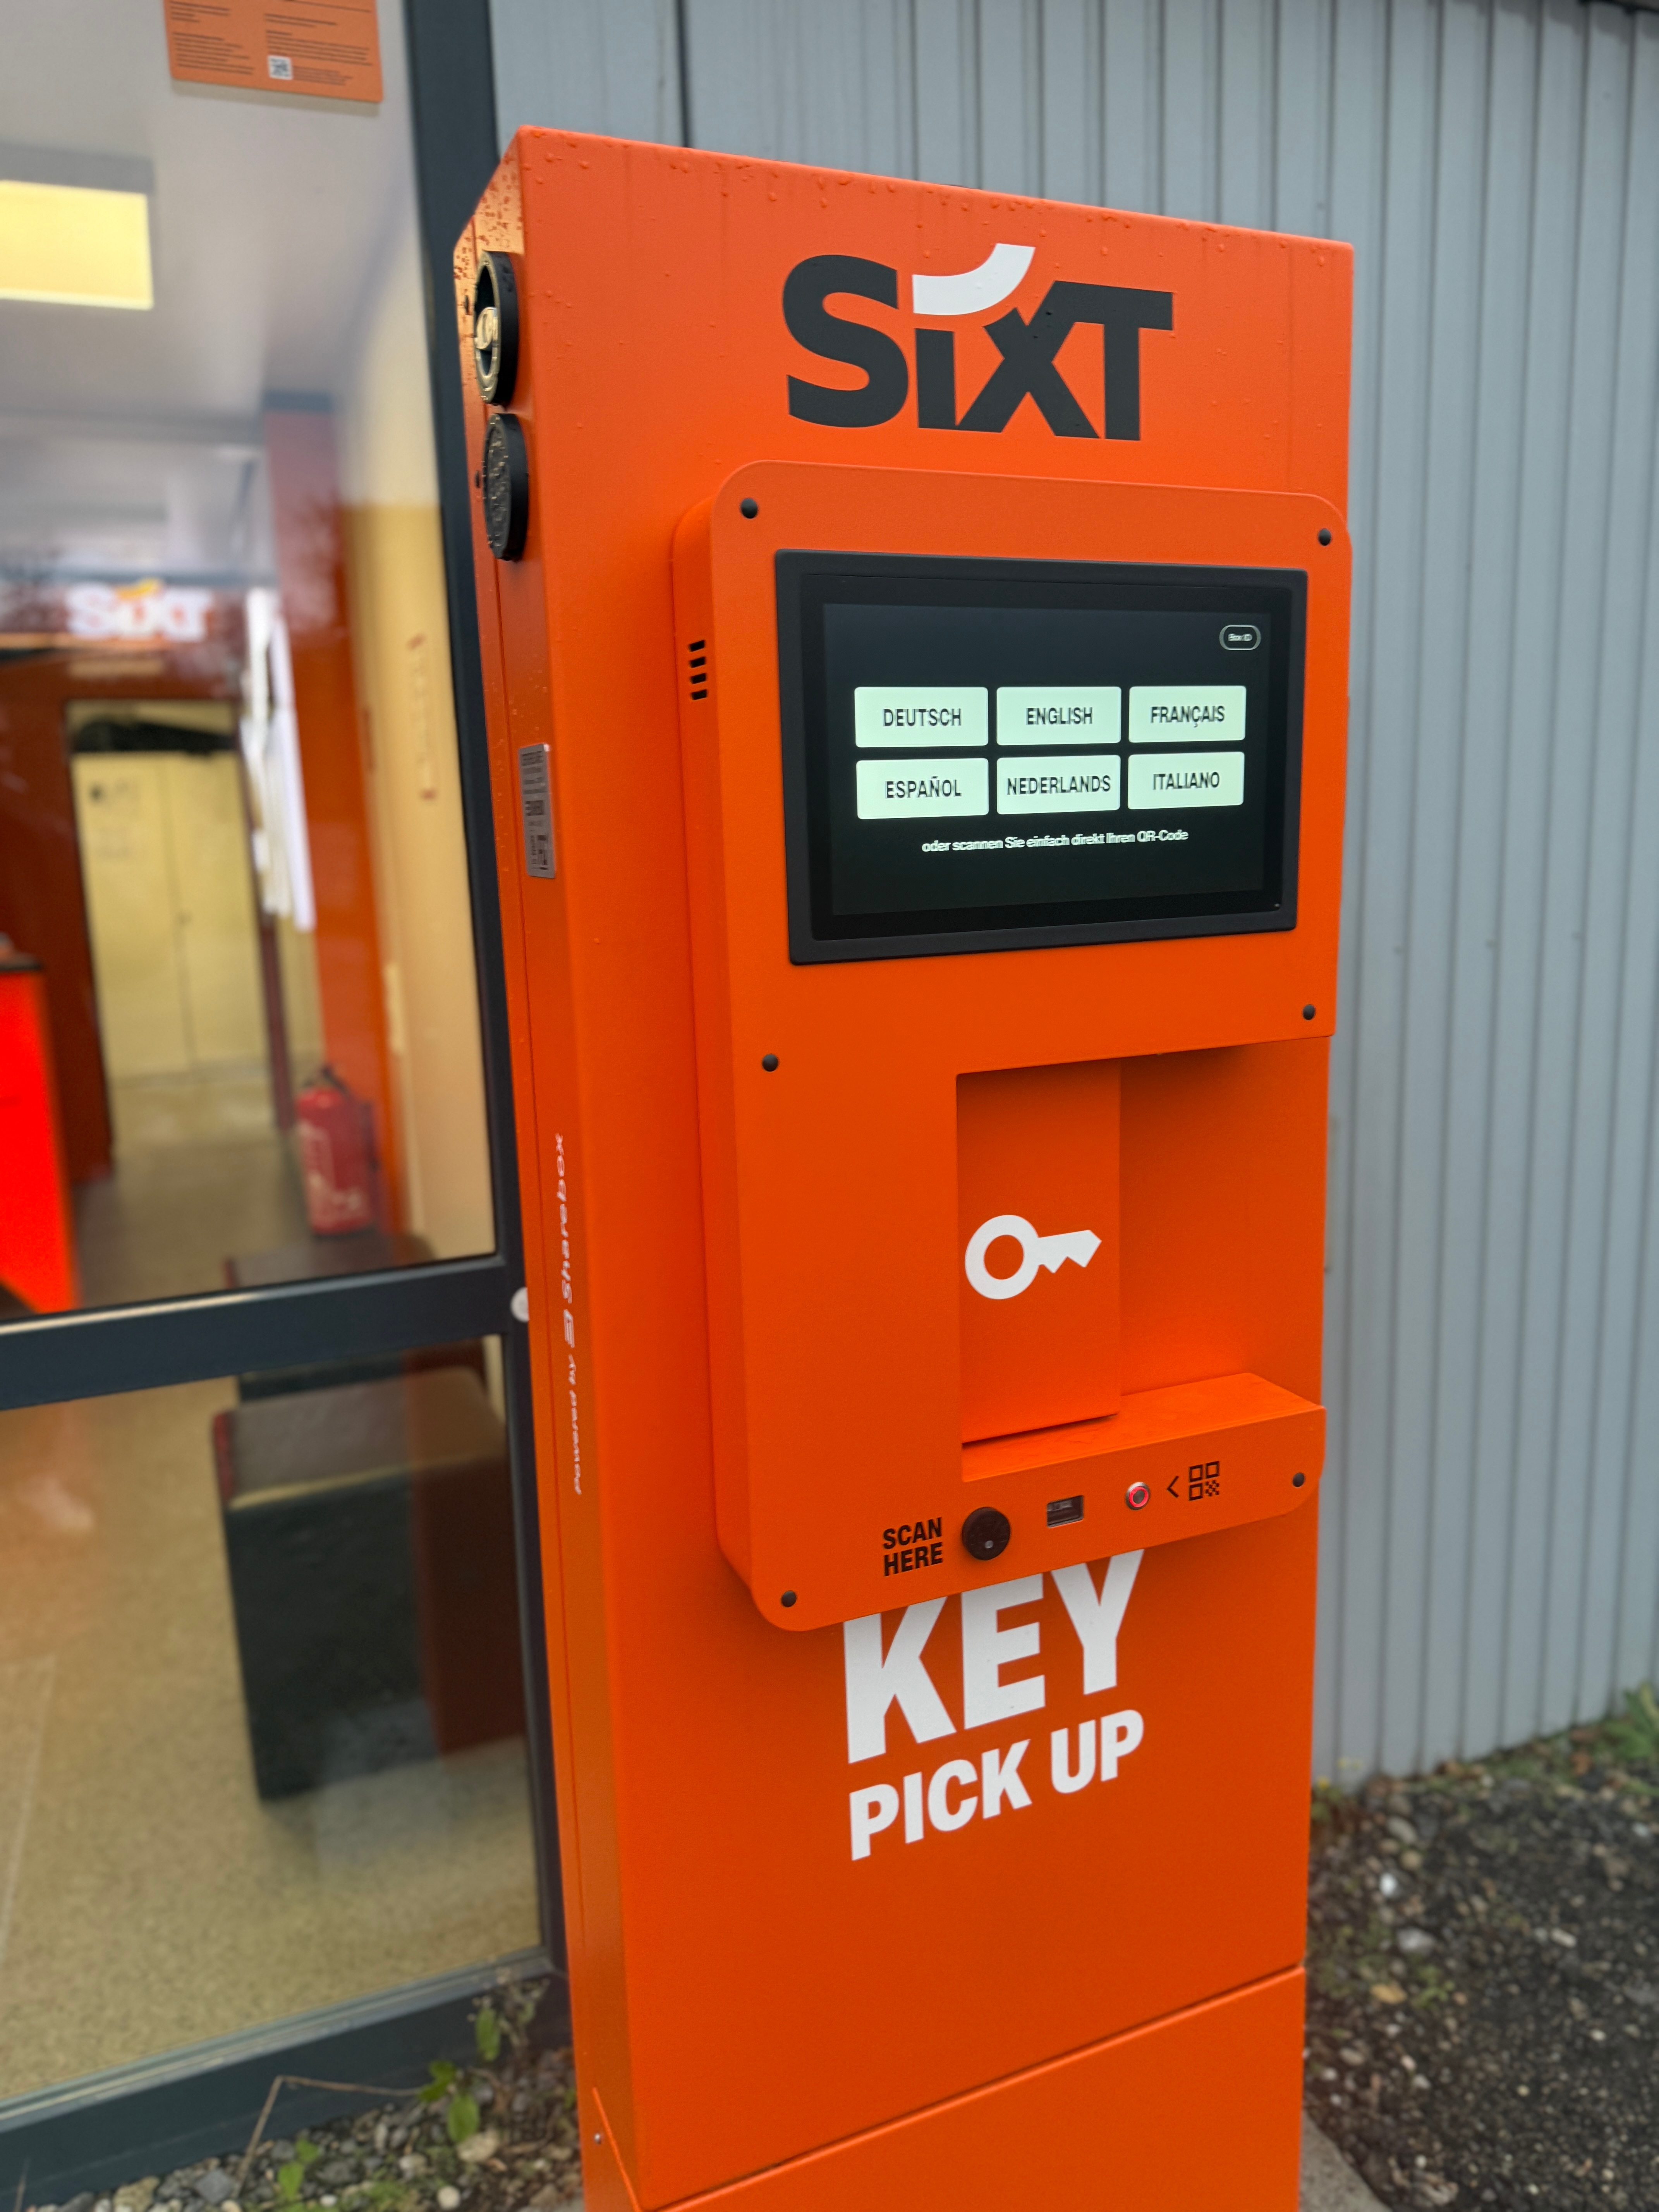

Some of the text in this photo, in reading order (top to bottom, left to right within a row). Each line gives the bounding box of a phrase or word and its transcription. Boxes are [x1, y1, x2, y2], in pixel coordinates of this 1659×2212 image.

[883, 708, 962, 726] DEUTSCH
[1026, 707, 1093, 725] ENGLISH
[1150, 706, 1226, 728] FRANÇAIS
[885, 776, 962, 799] ESPAÑOL
[1006, 775, 1111, 795] NEDERLANDS
[1152, 772, 1220, 790] ITALIANO
[922, 829, 1189, 852] oder scannen Sie einfach direkt Ihren QR-Code
[555, 1133, 572, 1304] Sharebox
[568, 1354, 577, 1386] by
[883, 1517, 943, 1550] SCAN
[883, 1542, 943, 1577] HERE
[843, 1549, 1145, 1764] KEY
[849, 1709, 1144, 1861] PICK UP
